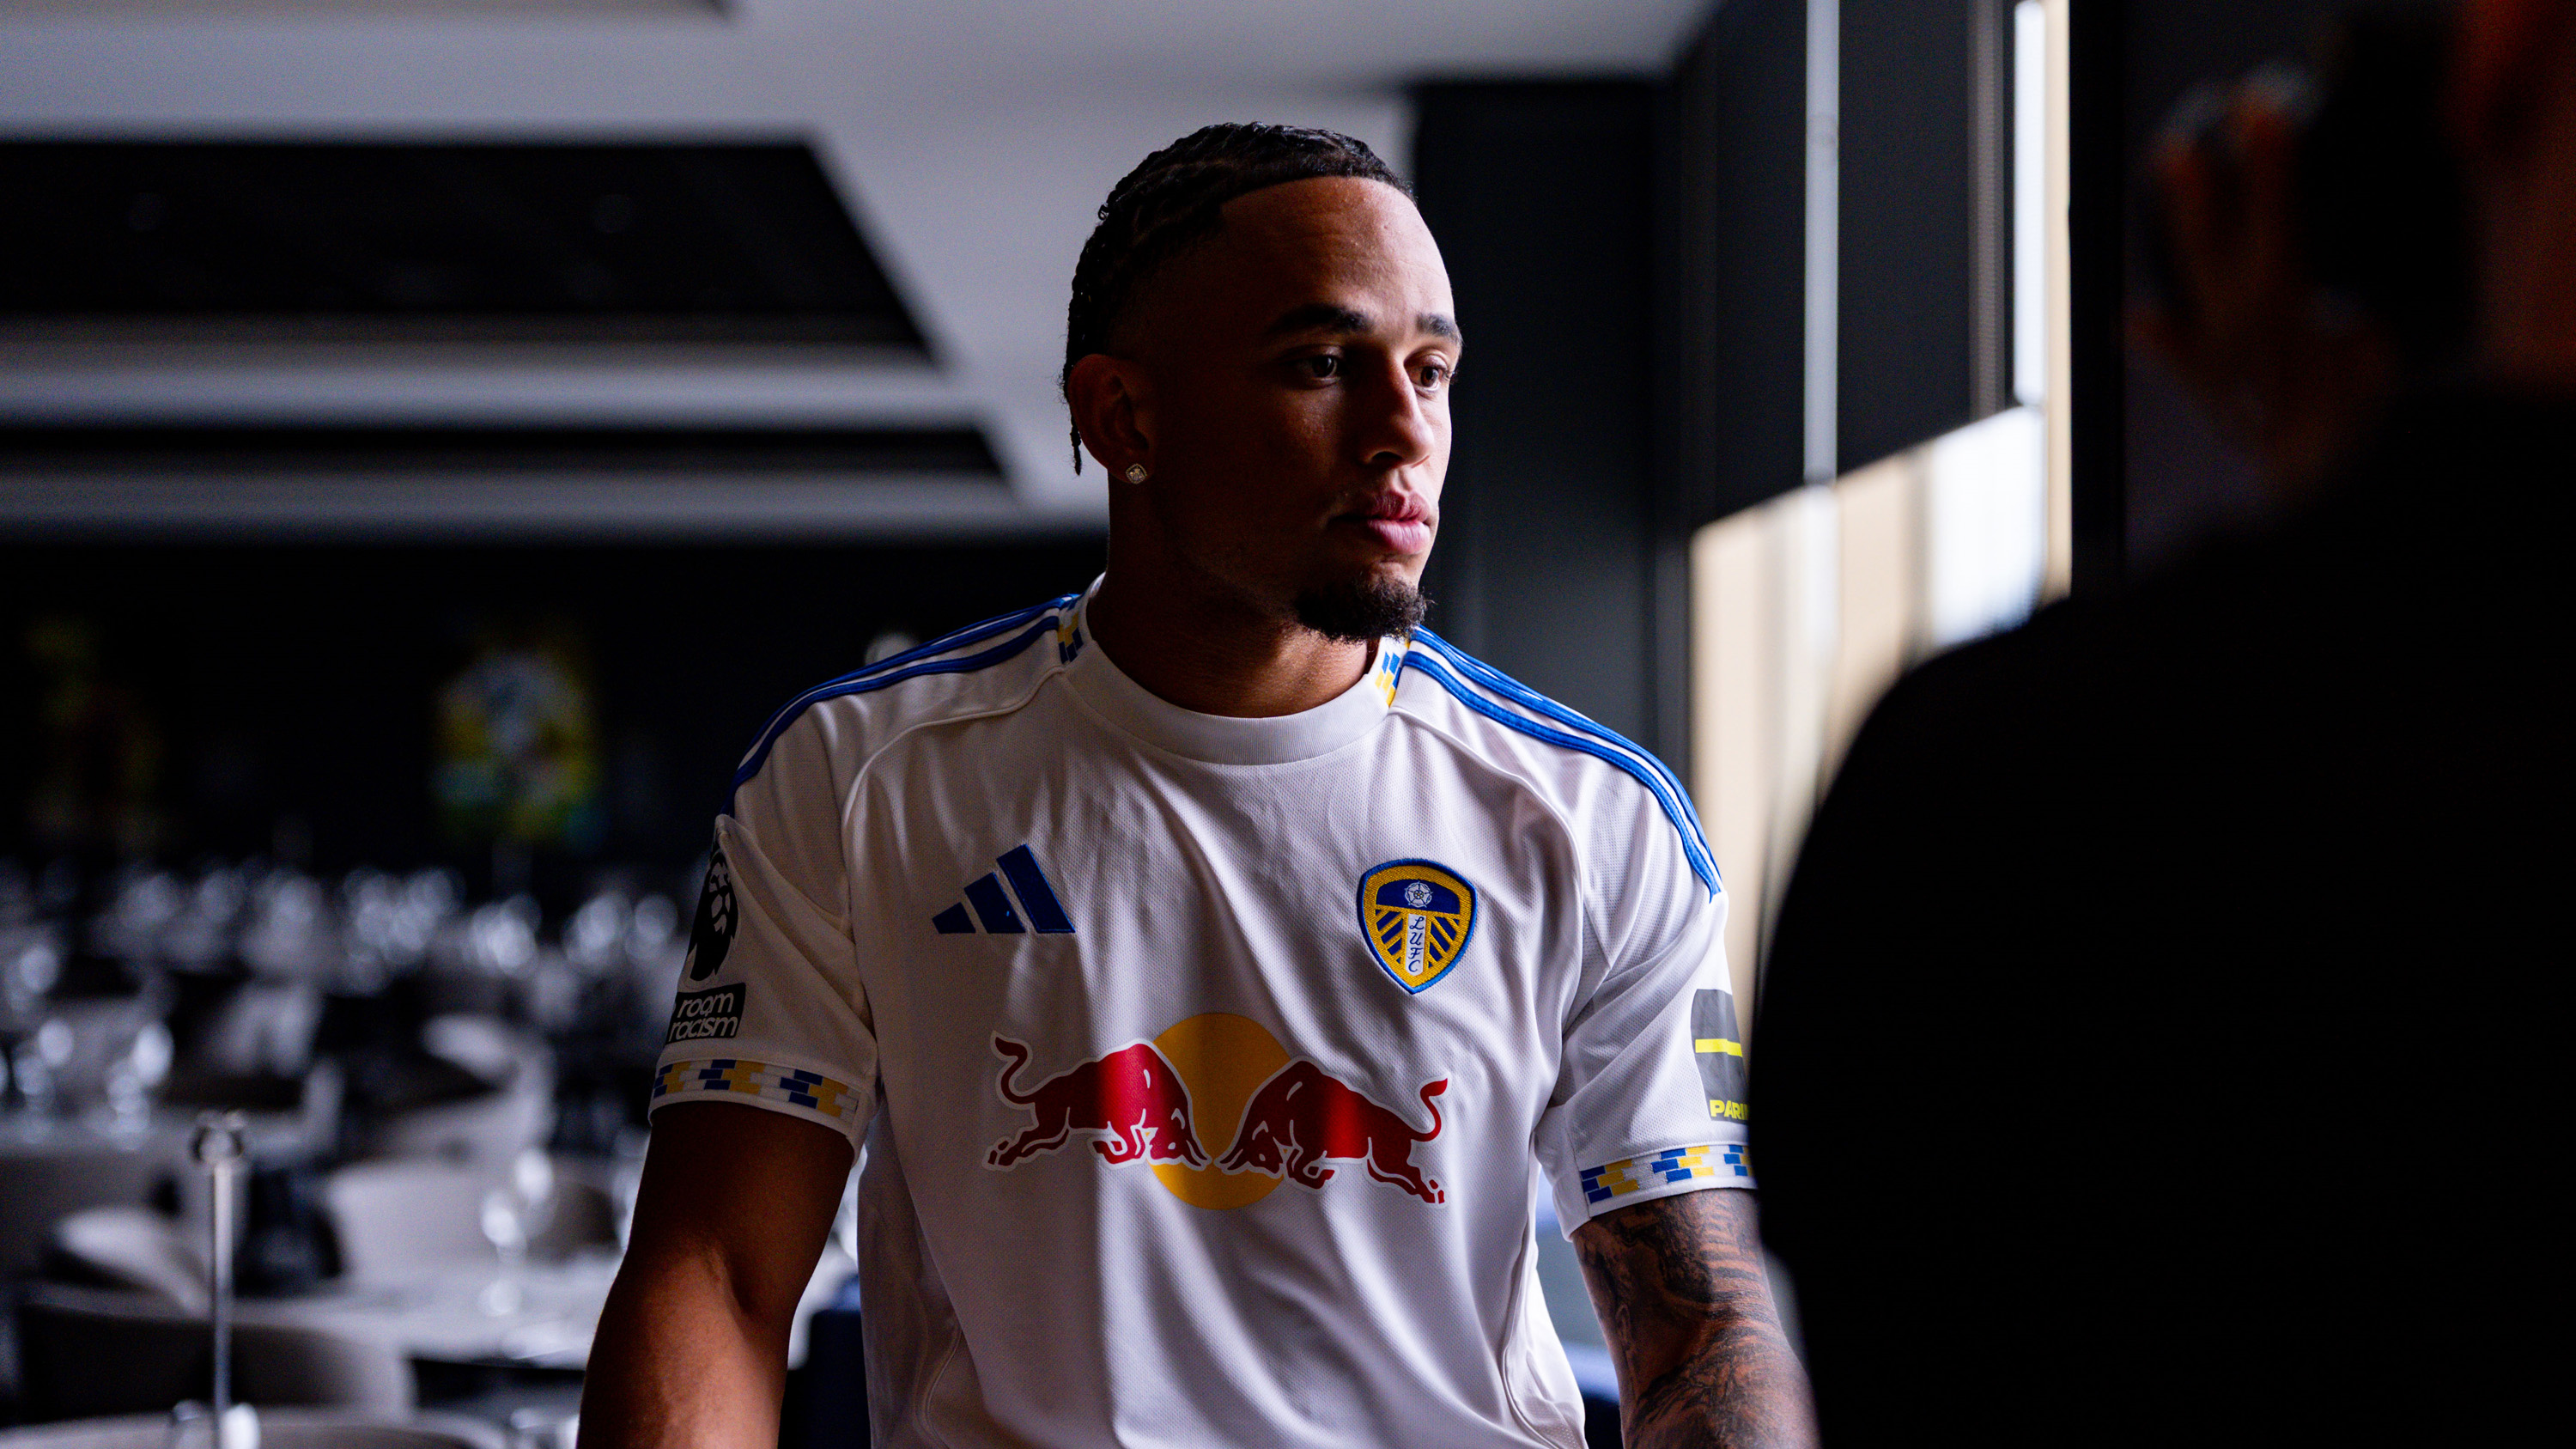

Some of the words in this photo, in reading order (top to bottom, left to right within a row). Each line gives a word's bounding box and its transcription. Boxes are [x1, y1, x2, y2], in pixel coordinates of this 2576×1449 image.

[1408, 916, 1425, 972] LUFC
[677, 992, 734, 1018] room
[668, 1017, 738, 1042] racism
